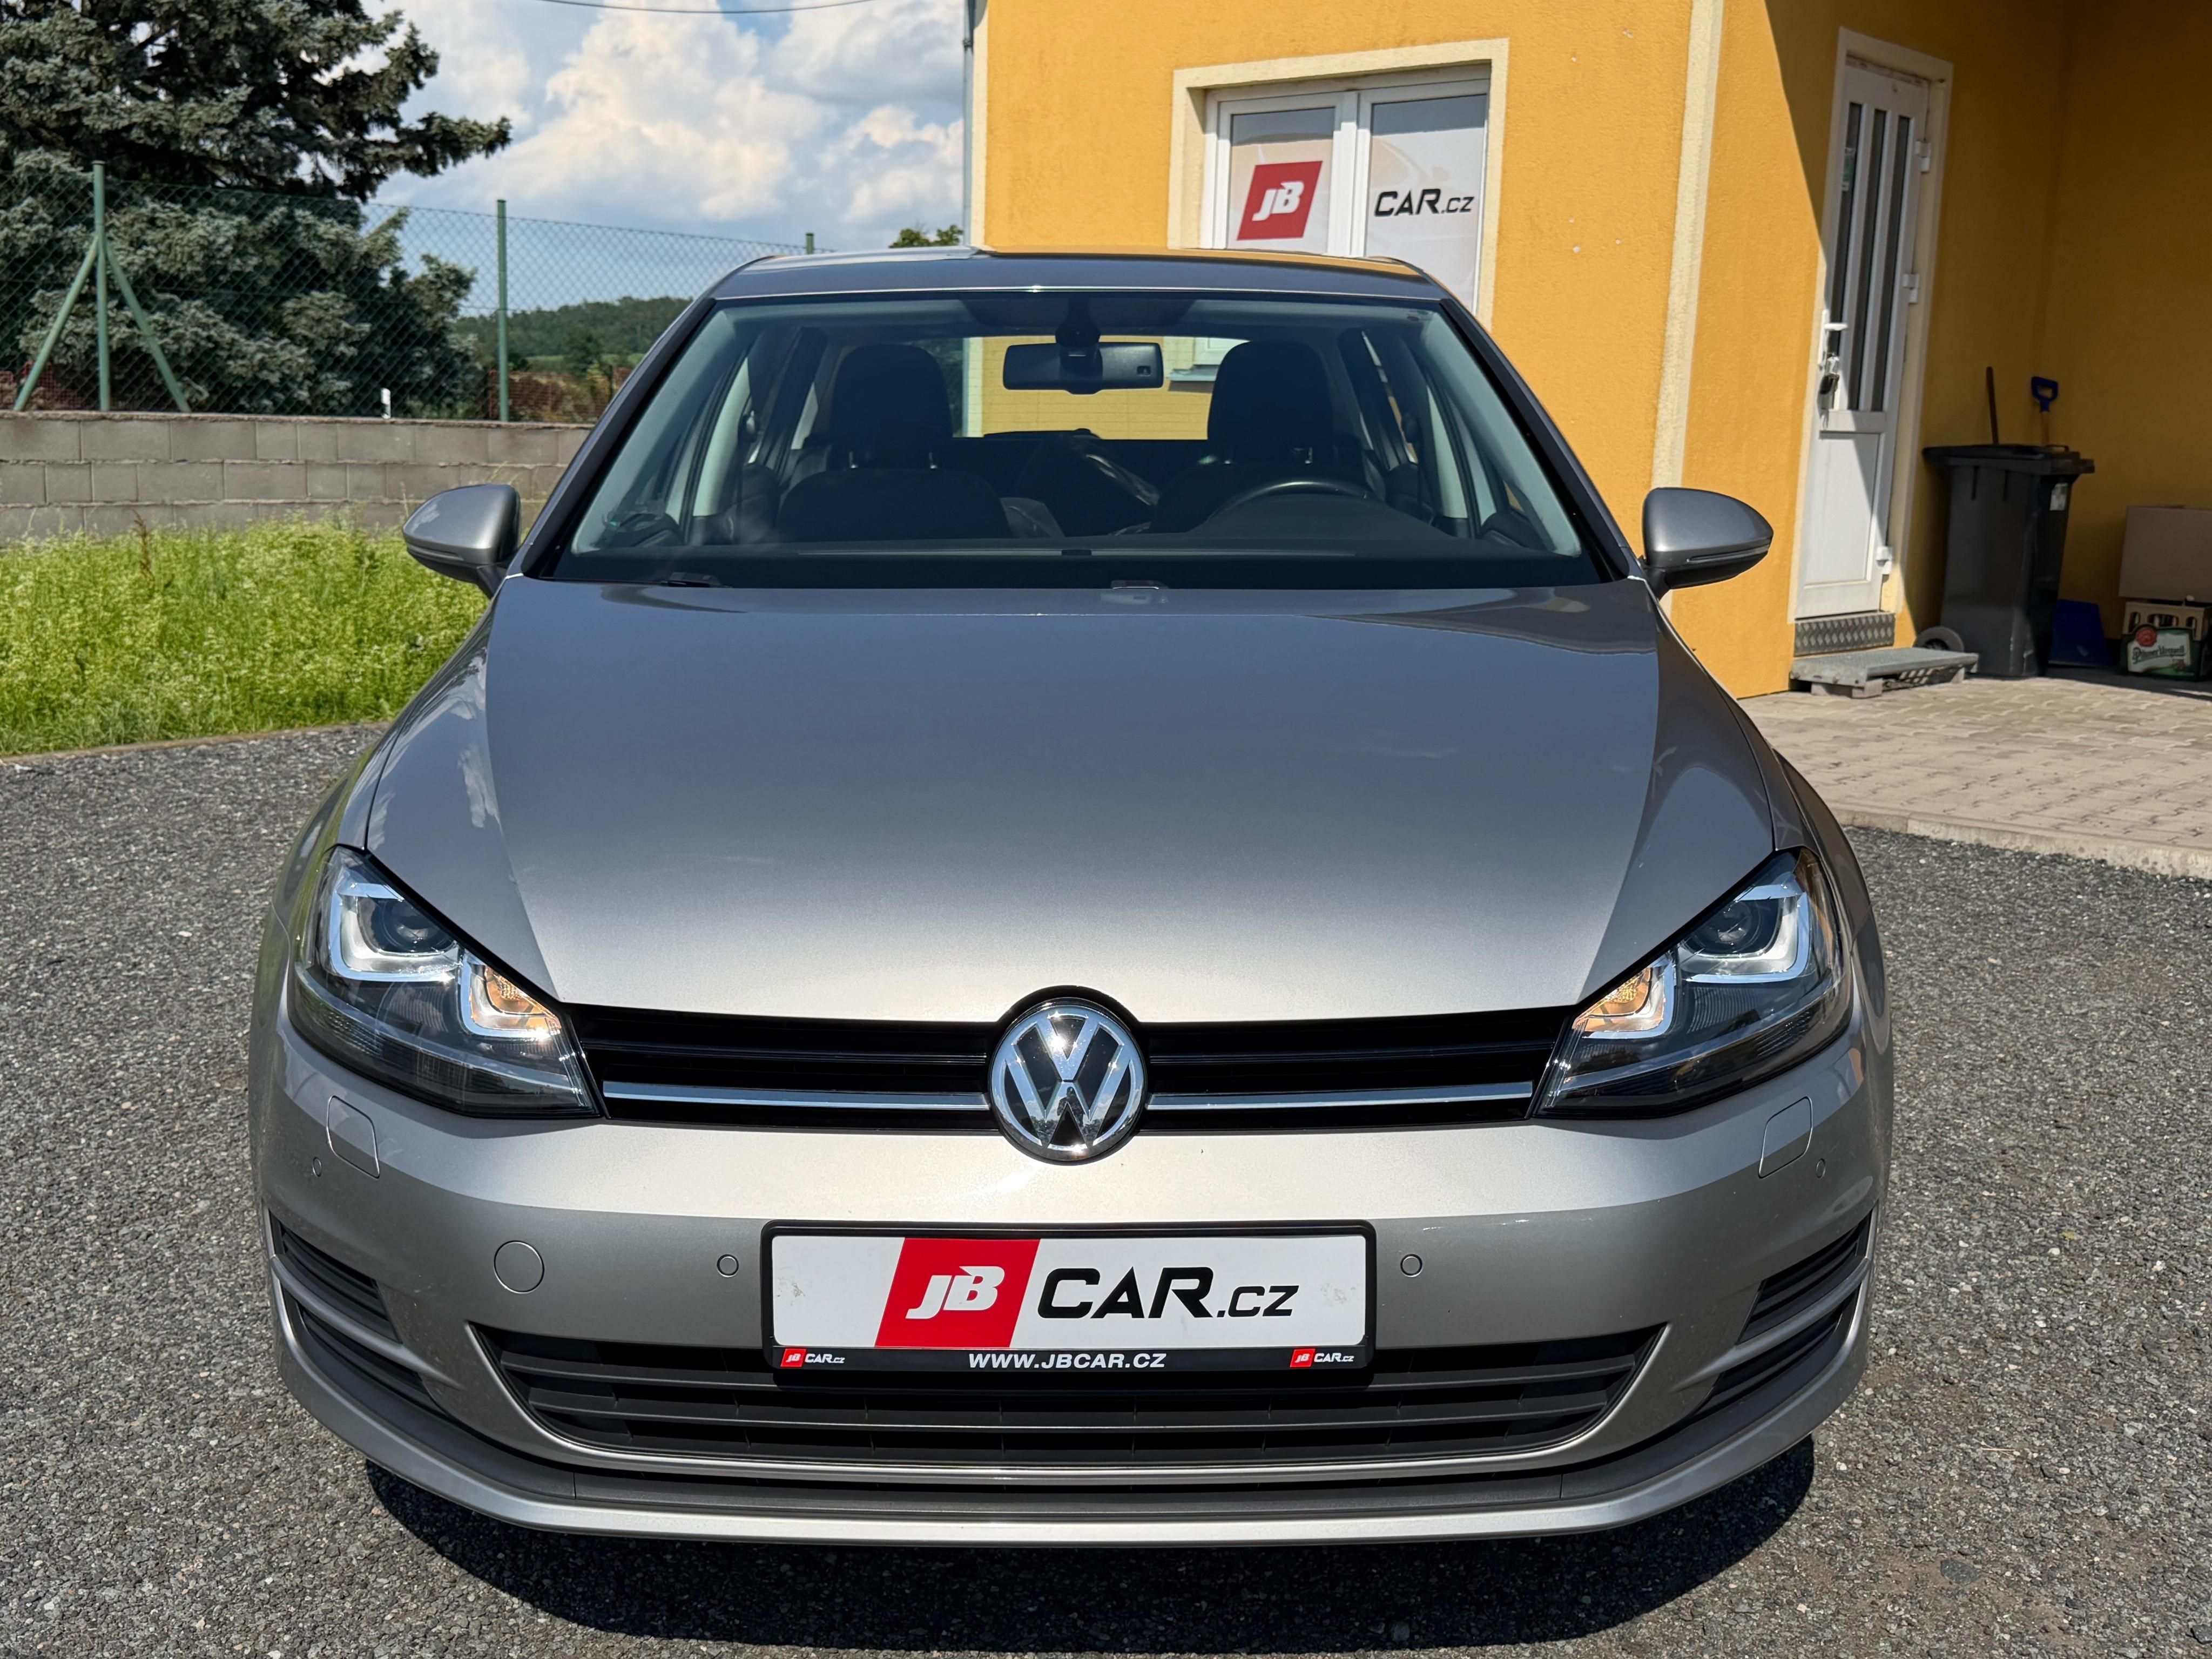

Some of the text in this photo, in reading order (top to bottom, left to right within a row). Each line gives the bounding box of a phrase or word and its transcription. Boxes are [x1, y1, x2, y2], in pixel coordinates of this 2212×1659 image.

[1252, 181, 1305, 222] JB
[905, 1266, 1005, 1319] JB
[786, 1353, 801, 1363] JB
[968, 1353, 1167, 1369] WWW.JBCAR.CZ
[1294, 1353, 1310, 1363] JB
